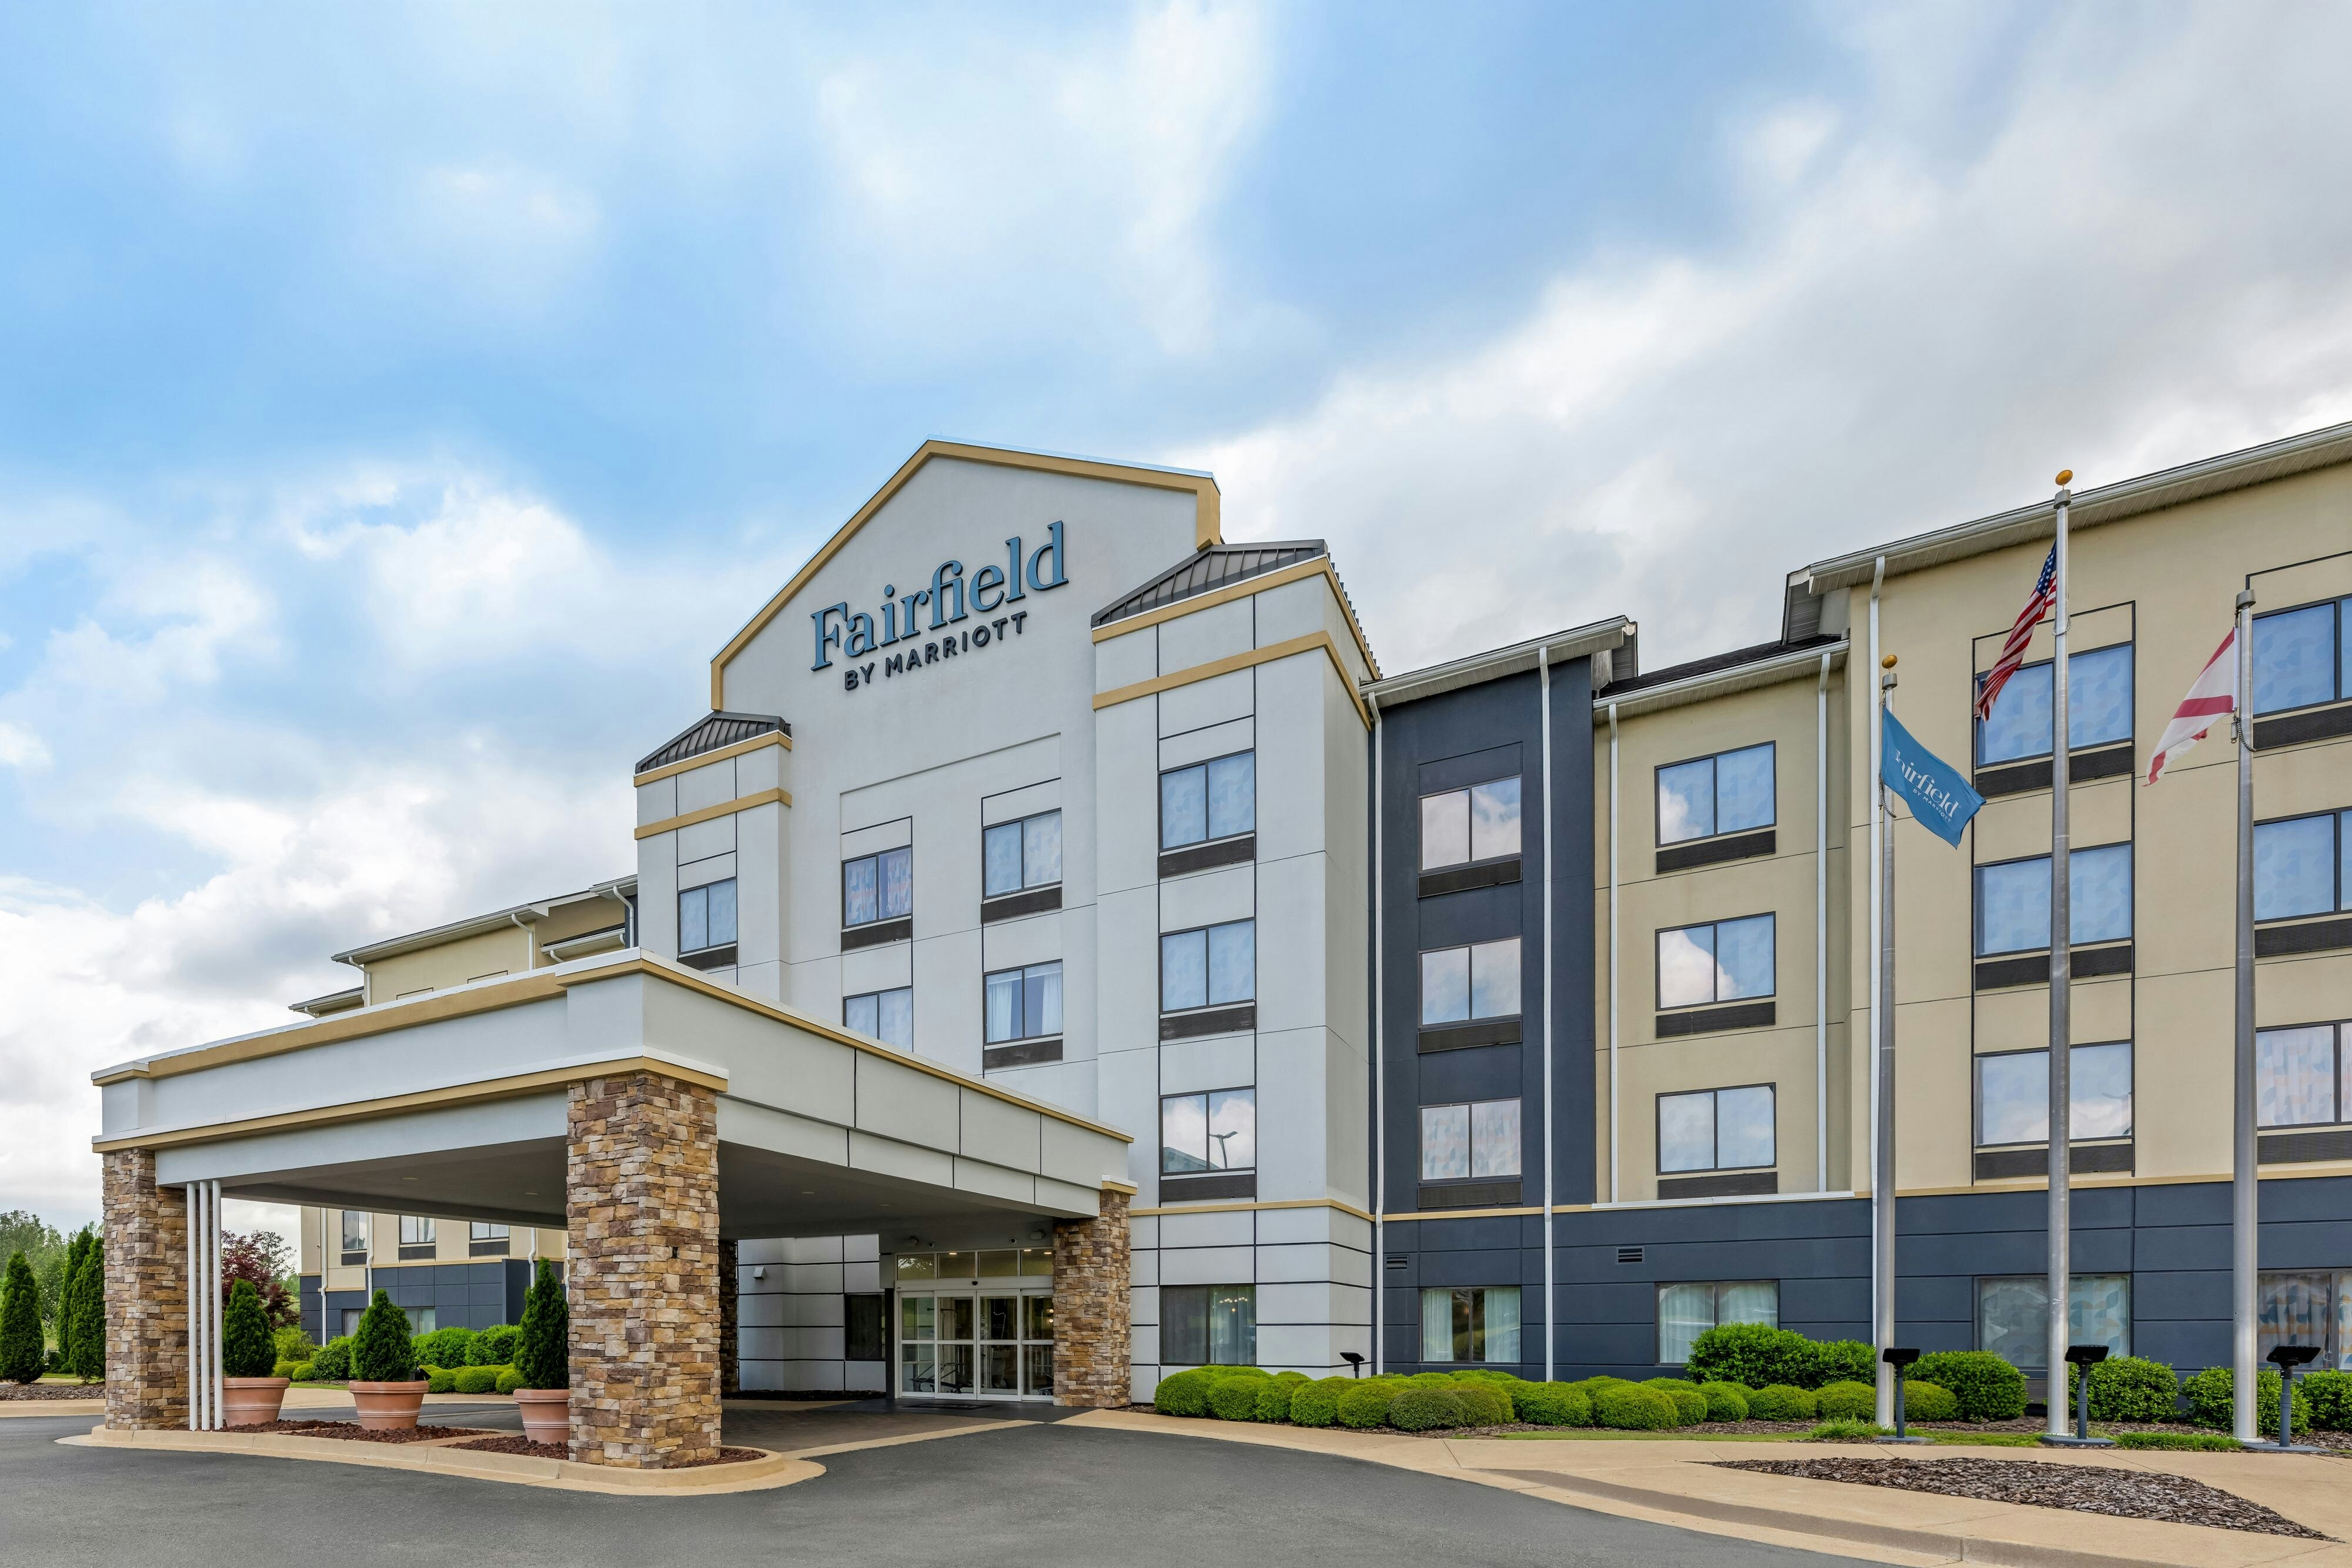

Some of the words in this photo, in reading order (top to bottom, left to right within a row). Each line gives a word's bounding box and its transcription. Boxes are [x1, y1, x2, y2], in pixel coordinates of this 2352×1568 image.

[810, 520, 1069, 671] Fairfield
[844, 662, 875, 691] BY
[885, 611, 1027, 677] MARRIOTT
[1913, 788, 1922, 797] BY
[1923, 795, 1952, 823] MARRIOTT
